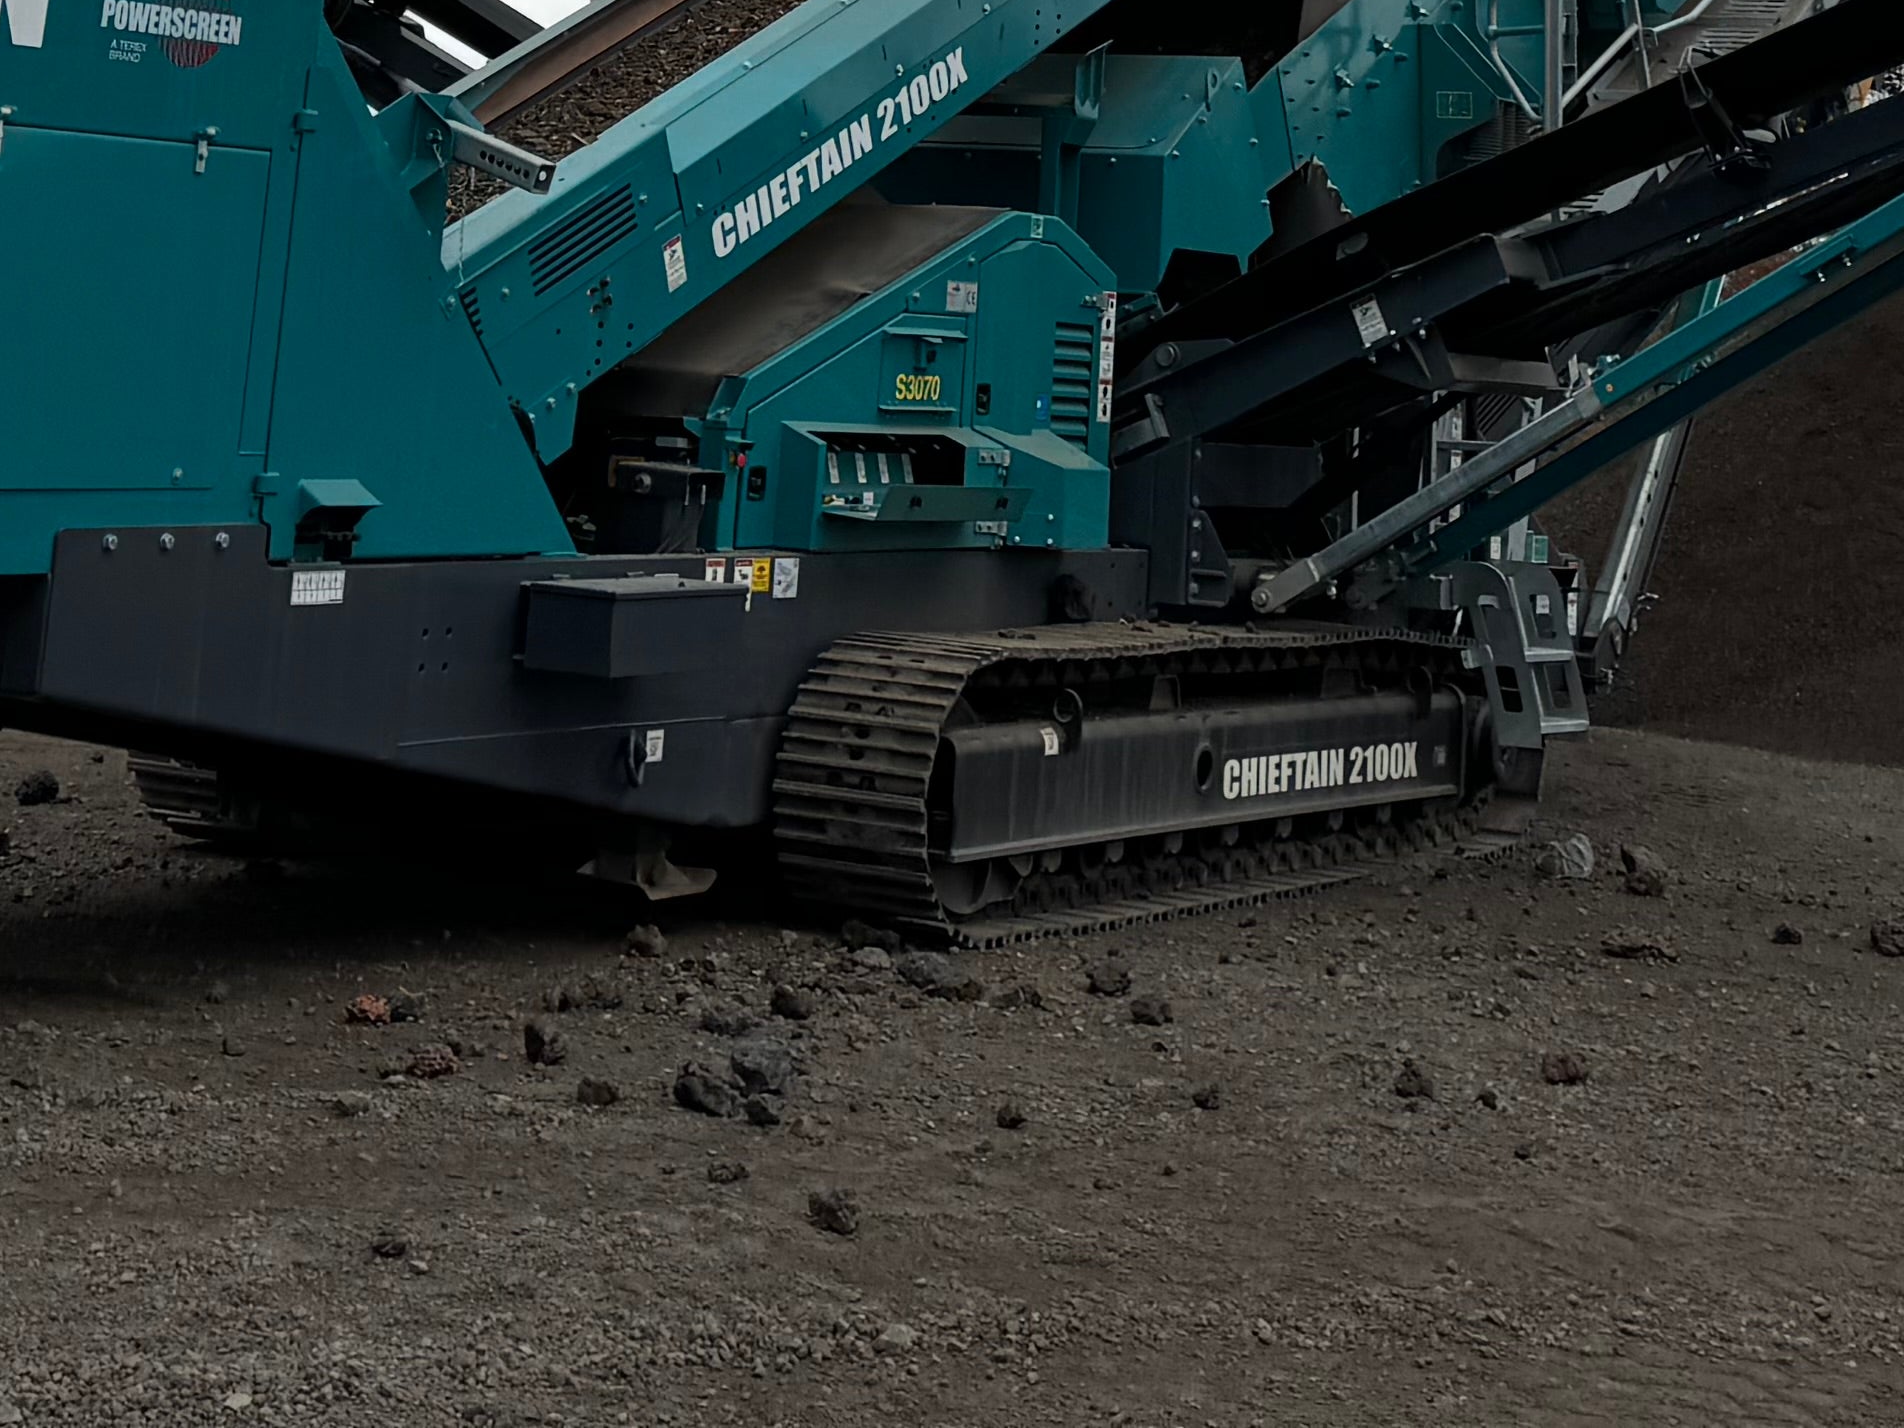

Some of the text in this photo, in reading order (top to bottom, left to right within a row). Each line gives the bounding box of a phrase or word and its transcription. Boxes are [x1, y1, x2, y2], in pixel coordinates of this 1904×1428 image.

[108, 50, 141, 63] BRAND
[711, 46, 968, 259] CHIEFTAIN 2100X
[895, 373, 941, 401] S3070
[1223, 741, 1418, 800] CHIEFTAIN 2100X
